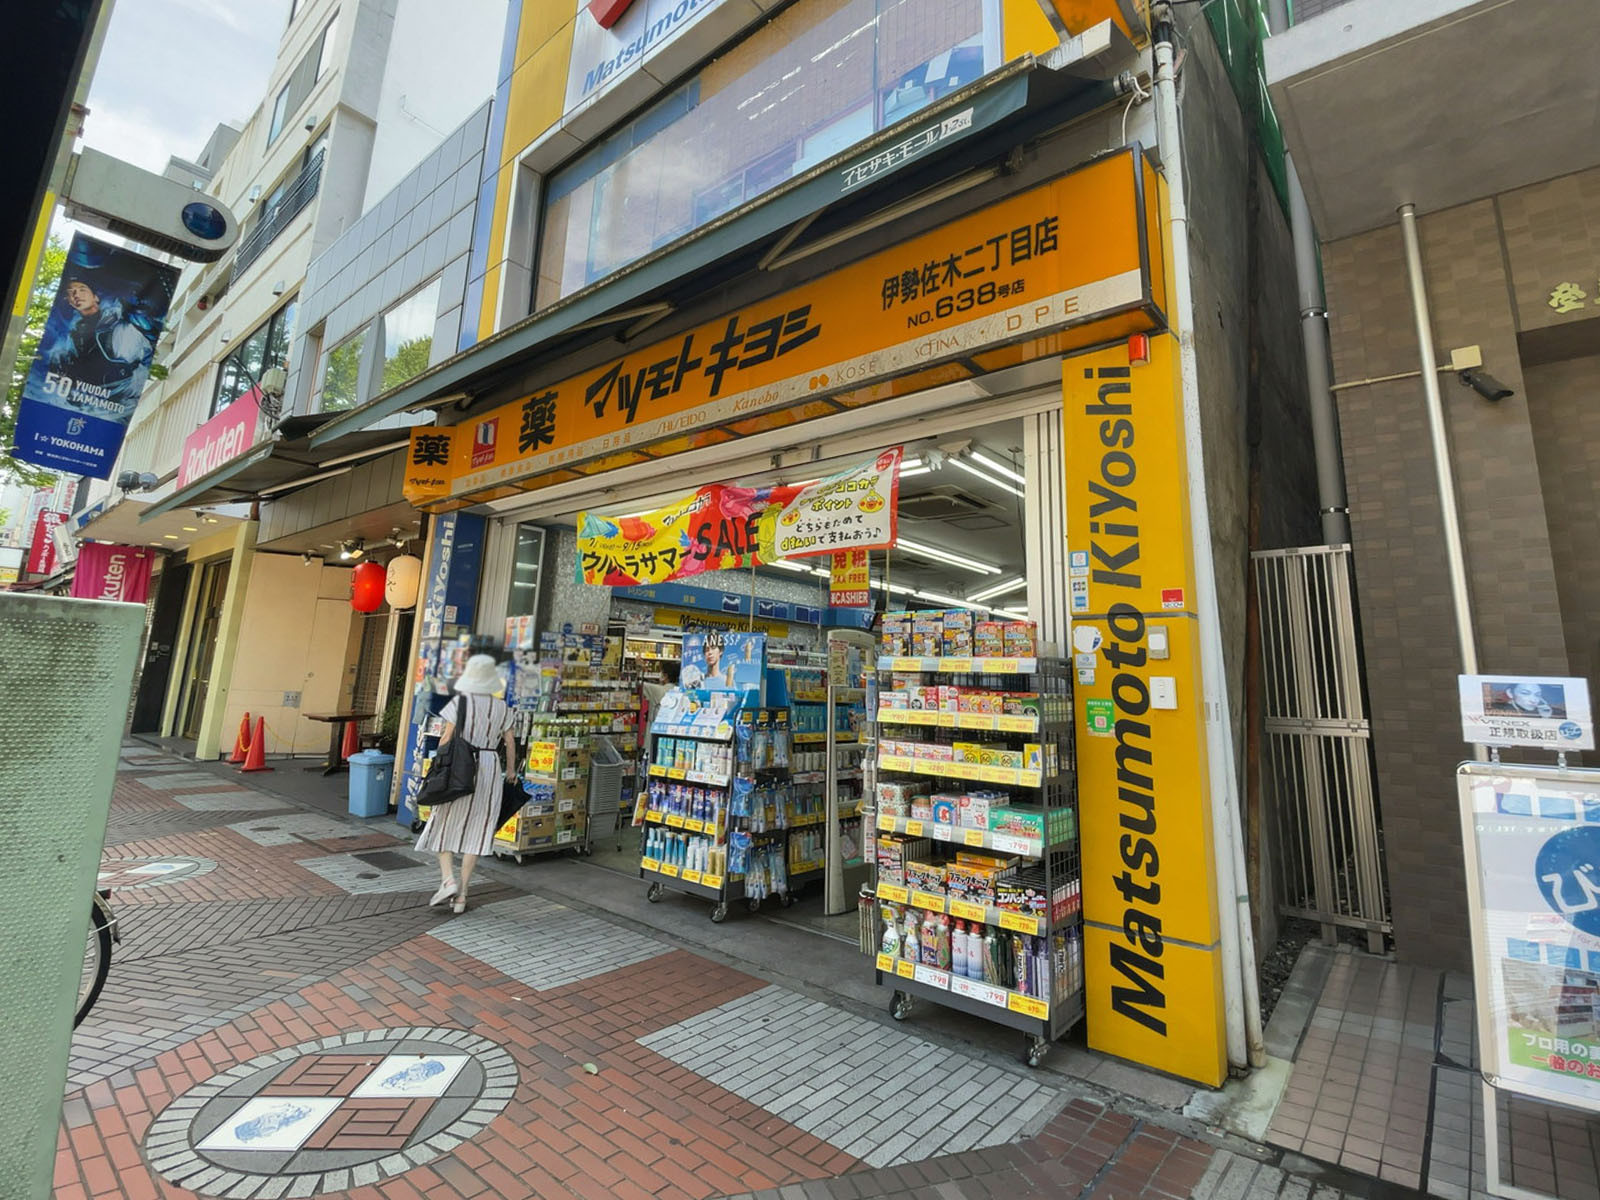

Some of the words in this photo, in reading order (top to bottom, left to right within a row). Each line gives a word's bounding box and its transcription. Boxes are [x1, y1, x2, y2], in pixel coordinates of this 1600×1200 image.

[582, 0, 708, 95] Matsumot
[881, 215, 1060, 311] 伊勢佐木二丁目店
[584, 303, 822, 424] マツモトキヨシ
[42, 372, 72, 398] 50
[75, 379, 111, 398] YUUDAI
[71, 390, 125, 415] YAMAMOTO
[732, 391, 780, 413] Kanebo
[518, 390, 559, 454] 薬
[50, 436, 105, 457] YOKOHAMA
[413, 434, 451, 466] 薬
[582, 546, 692, 577] ウルトラサマー
[693, 511, 760, 562] SALE
[98, 553, 126, 600] kuten
[1489, 726, 1557, 741] 正規取扱店
[1100, 602, 1168, 1037] Matsumoto
[997, 891, 1029, 905] コンバット
